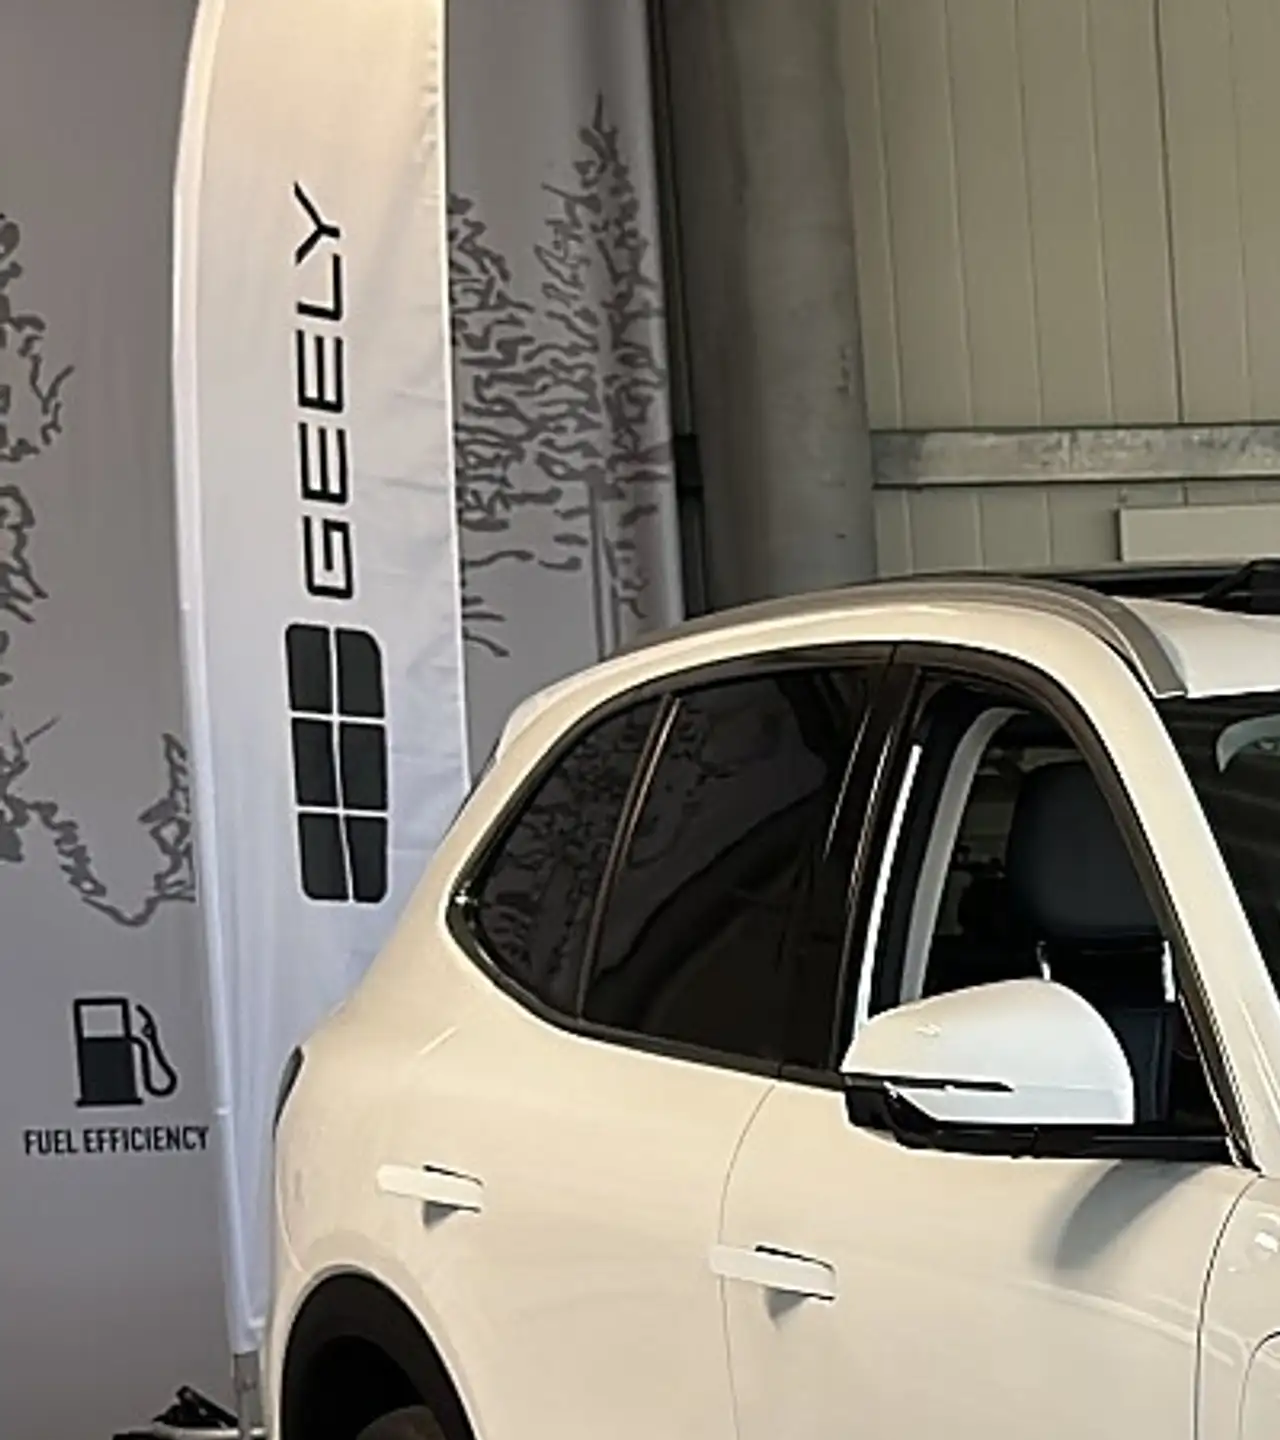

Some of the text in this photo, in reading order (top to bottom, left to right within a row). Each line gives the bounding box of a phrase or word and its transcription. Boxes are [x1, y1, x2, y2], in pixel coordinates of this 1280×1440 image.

[293, 181, 354, 599] GEELY
[23, 1125, 210, 1156] FUEL EFFICIENCY
